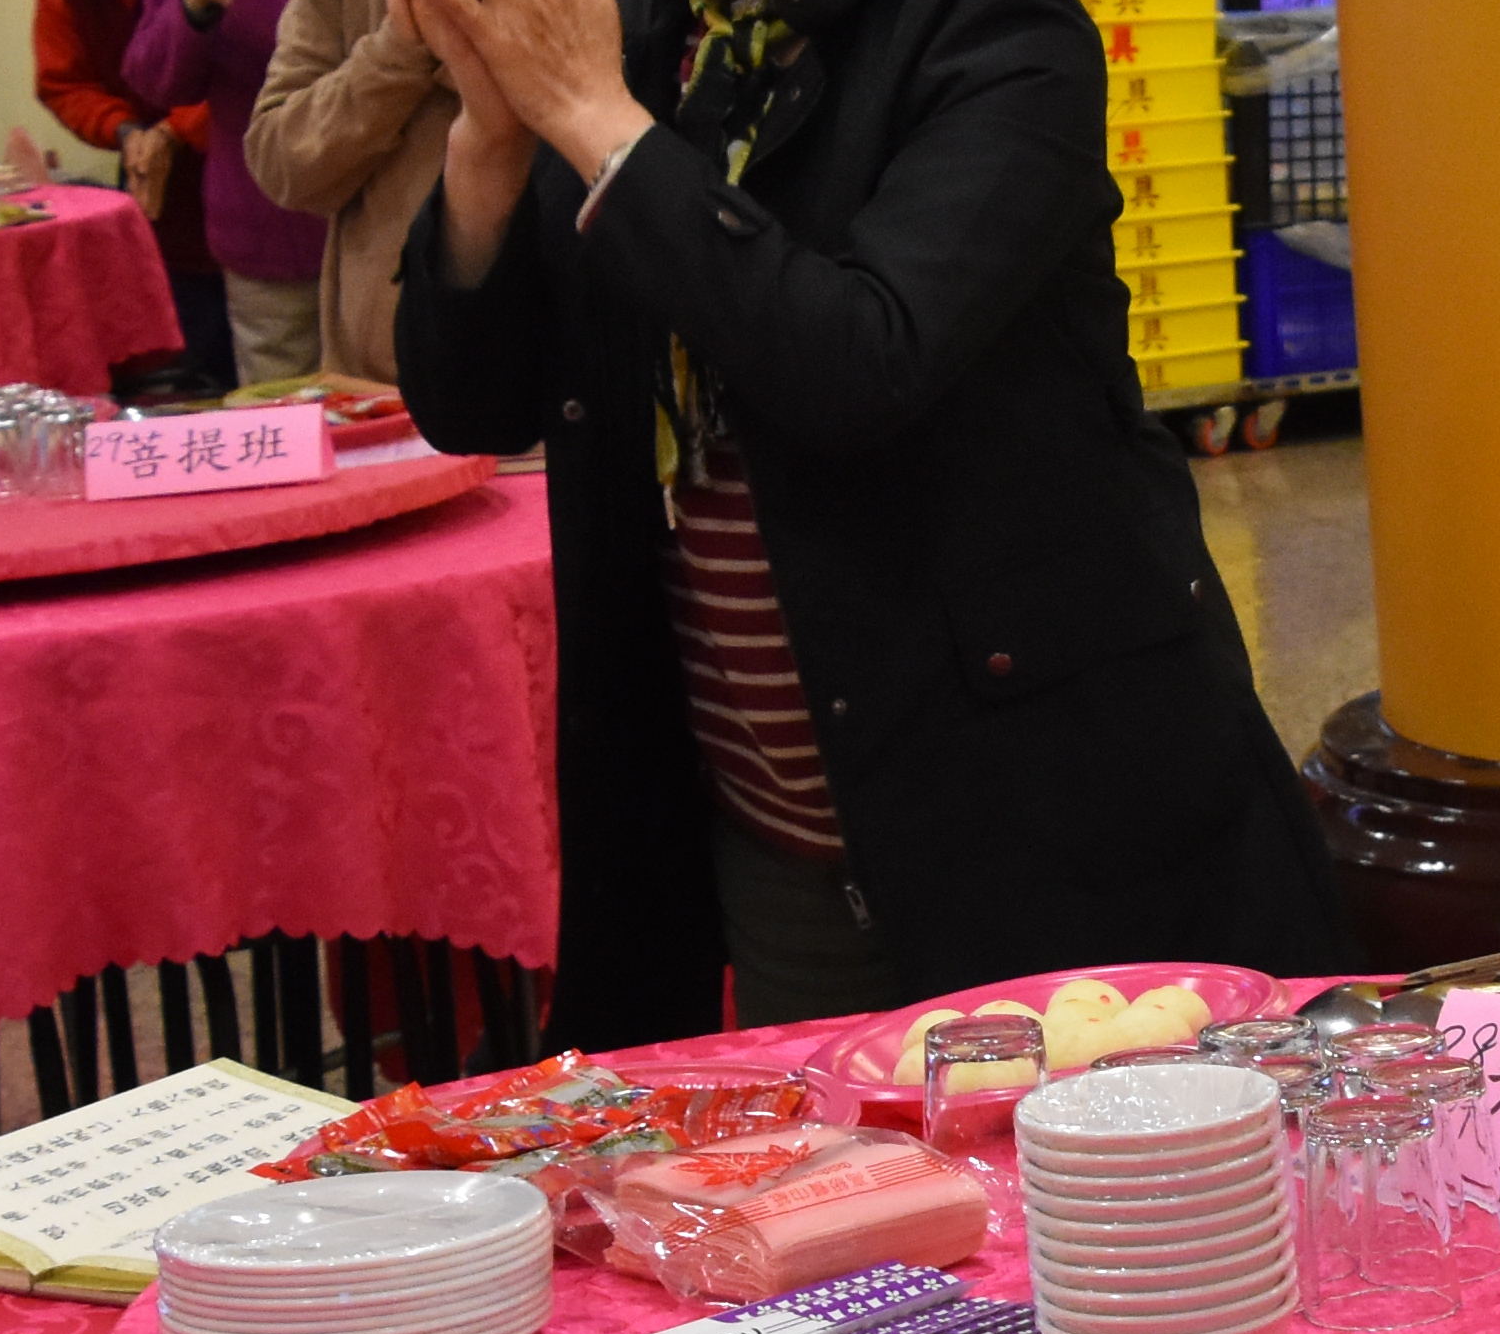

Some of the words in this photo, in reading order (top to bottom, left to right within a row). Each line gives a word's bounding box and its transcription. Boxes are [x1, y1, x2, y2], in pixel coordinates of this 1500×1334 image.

[122, 424, 289, 478] 菩提班
[763, 1170, 869, 1208] 高級餐巾紙
